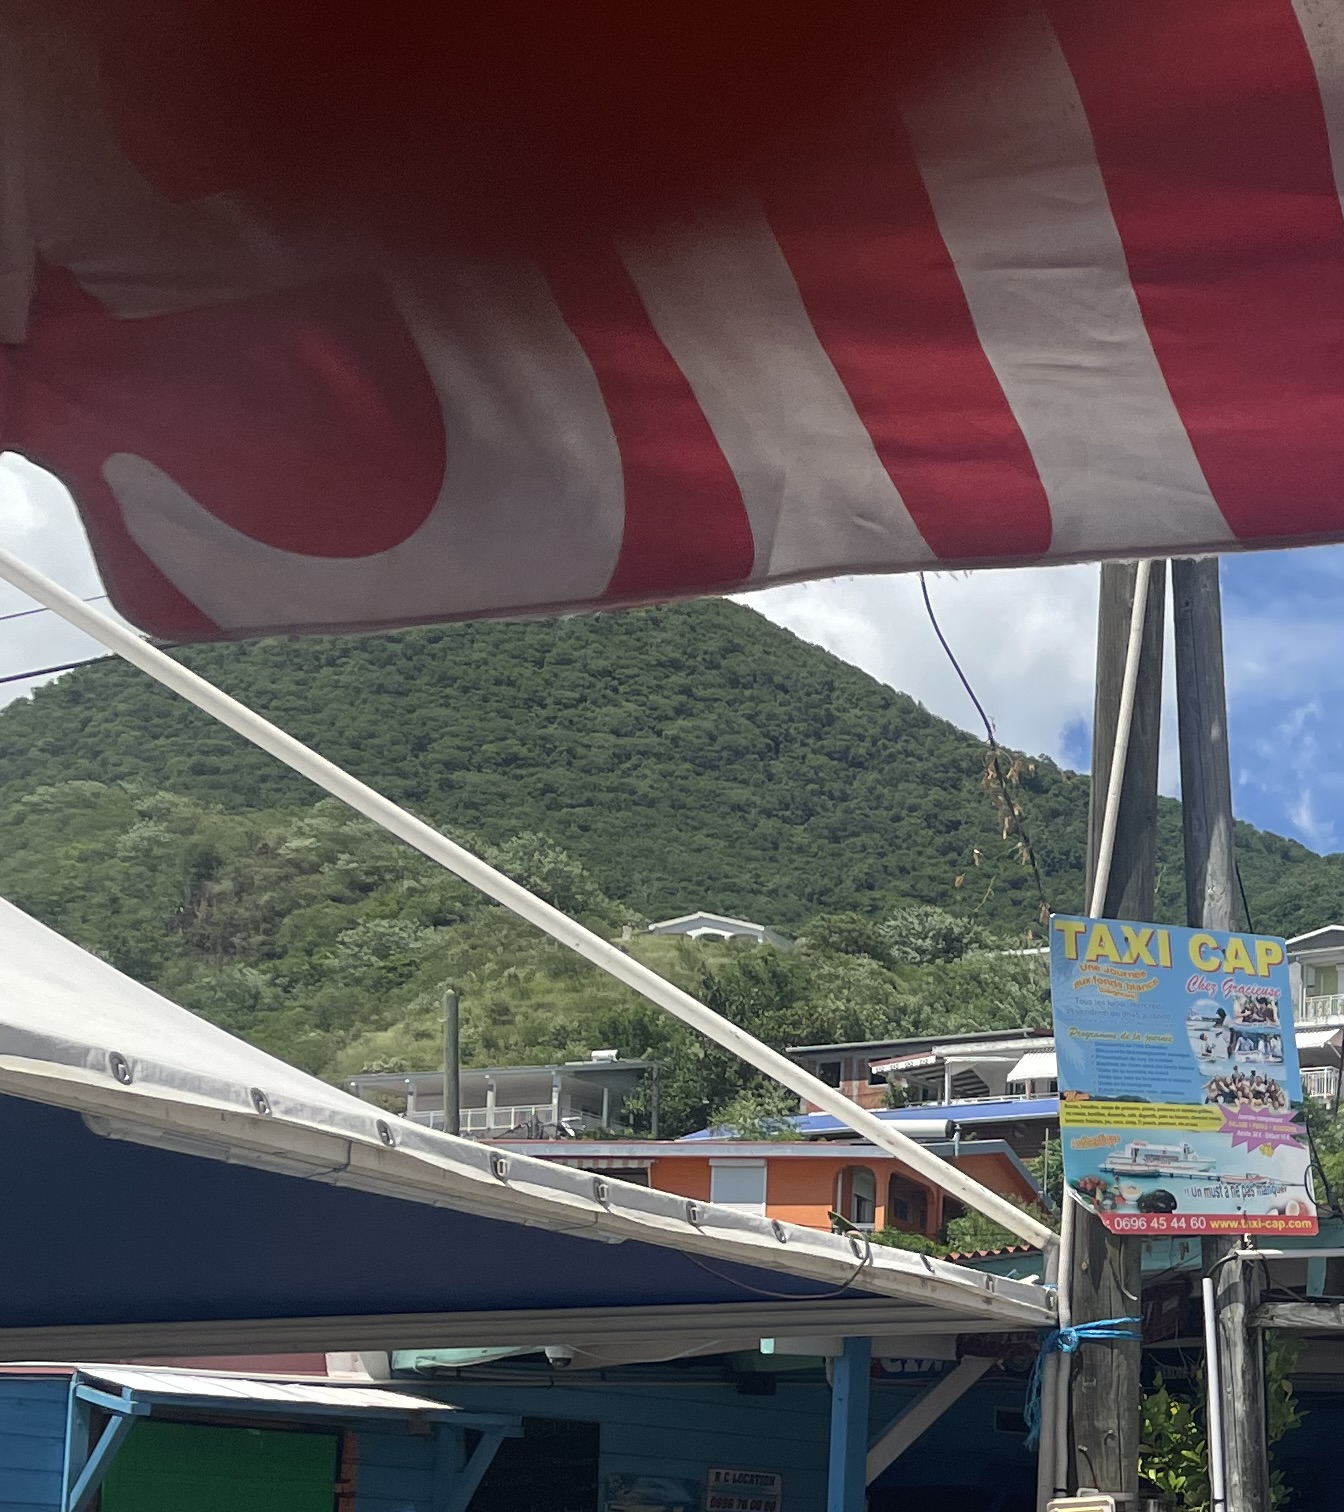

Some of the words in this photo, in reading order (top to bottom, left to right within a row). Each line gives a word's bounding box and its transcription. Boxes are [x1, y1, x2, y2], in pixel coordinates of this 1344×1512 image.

[1055, 920, 1172, 968] TAXI
[1188, 932, 1284, 977] CAP
[1187, 974, 1217, 996] Chez
[1222, 978, 1281, 998] Gracieuse
[1114, 1217, 1147, 1230] 0696
[1150, 1217, 1167, 1229] 45
[1170, 1217, 1187, 1229] 44
[1190, 1216, 1206, 1229] 60
[732, 1473, 776, 1486] LOCATION
